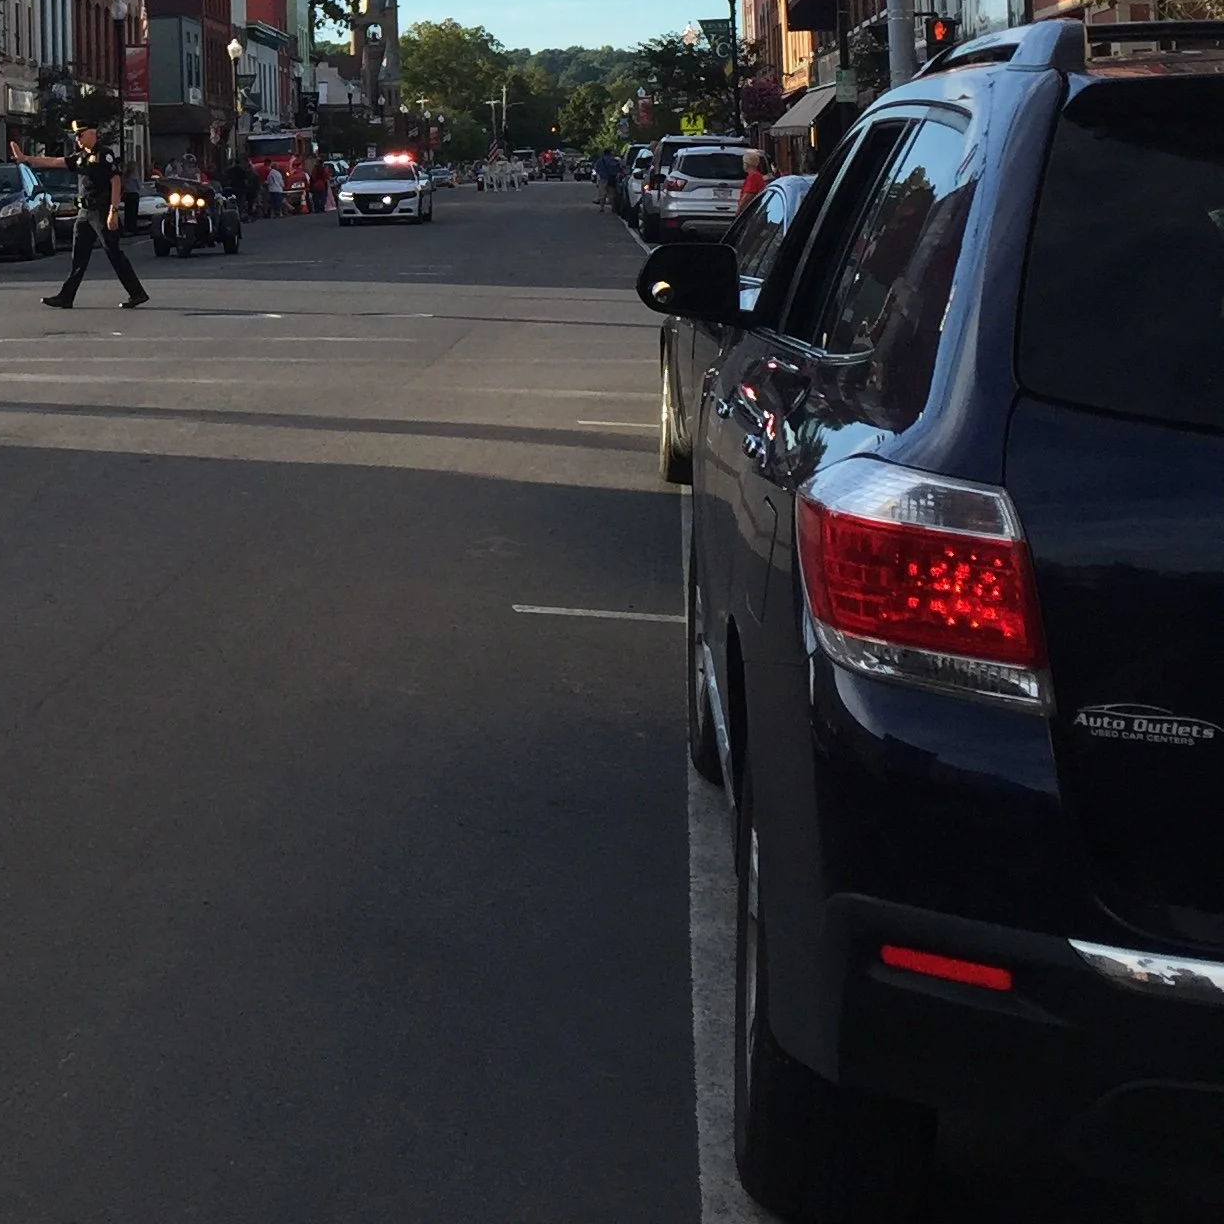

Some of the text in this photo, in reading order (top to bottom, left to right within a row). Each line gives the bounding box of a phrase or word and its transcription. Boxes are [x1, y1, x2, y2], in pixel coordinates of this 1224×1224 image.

[1073, 713, 1215, 739] Auto Outlets
[1091, 729, 1195, 746] USED CAR CENTERS
